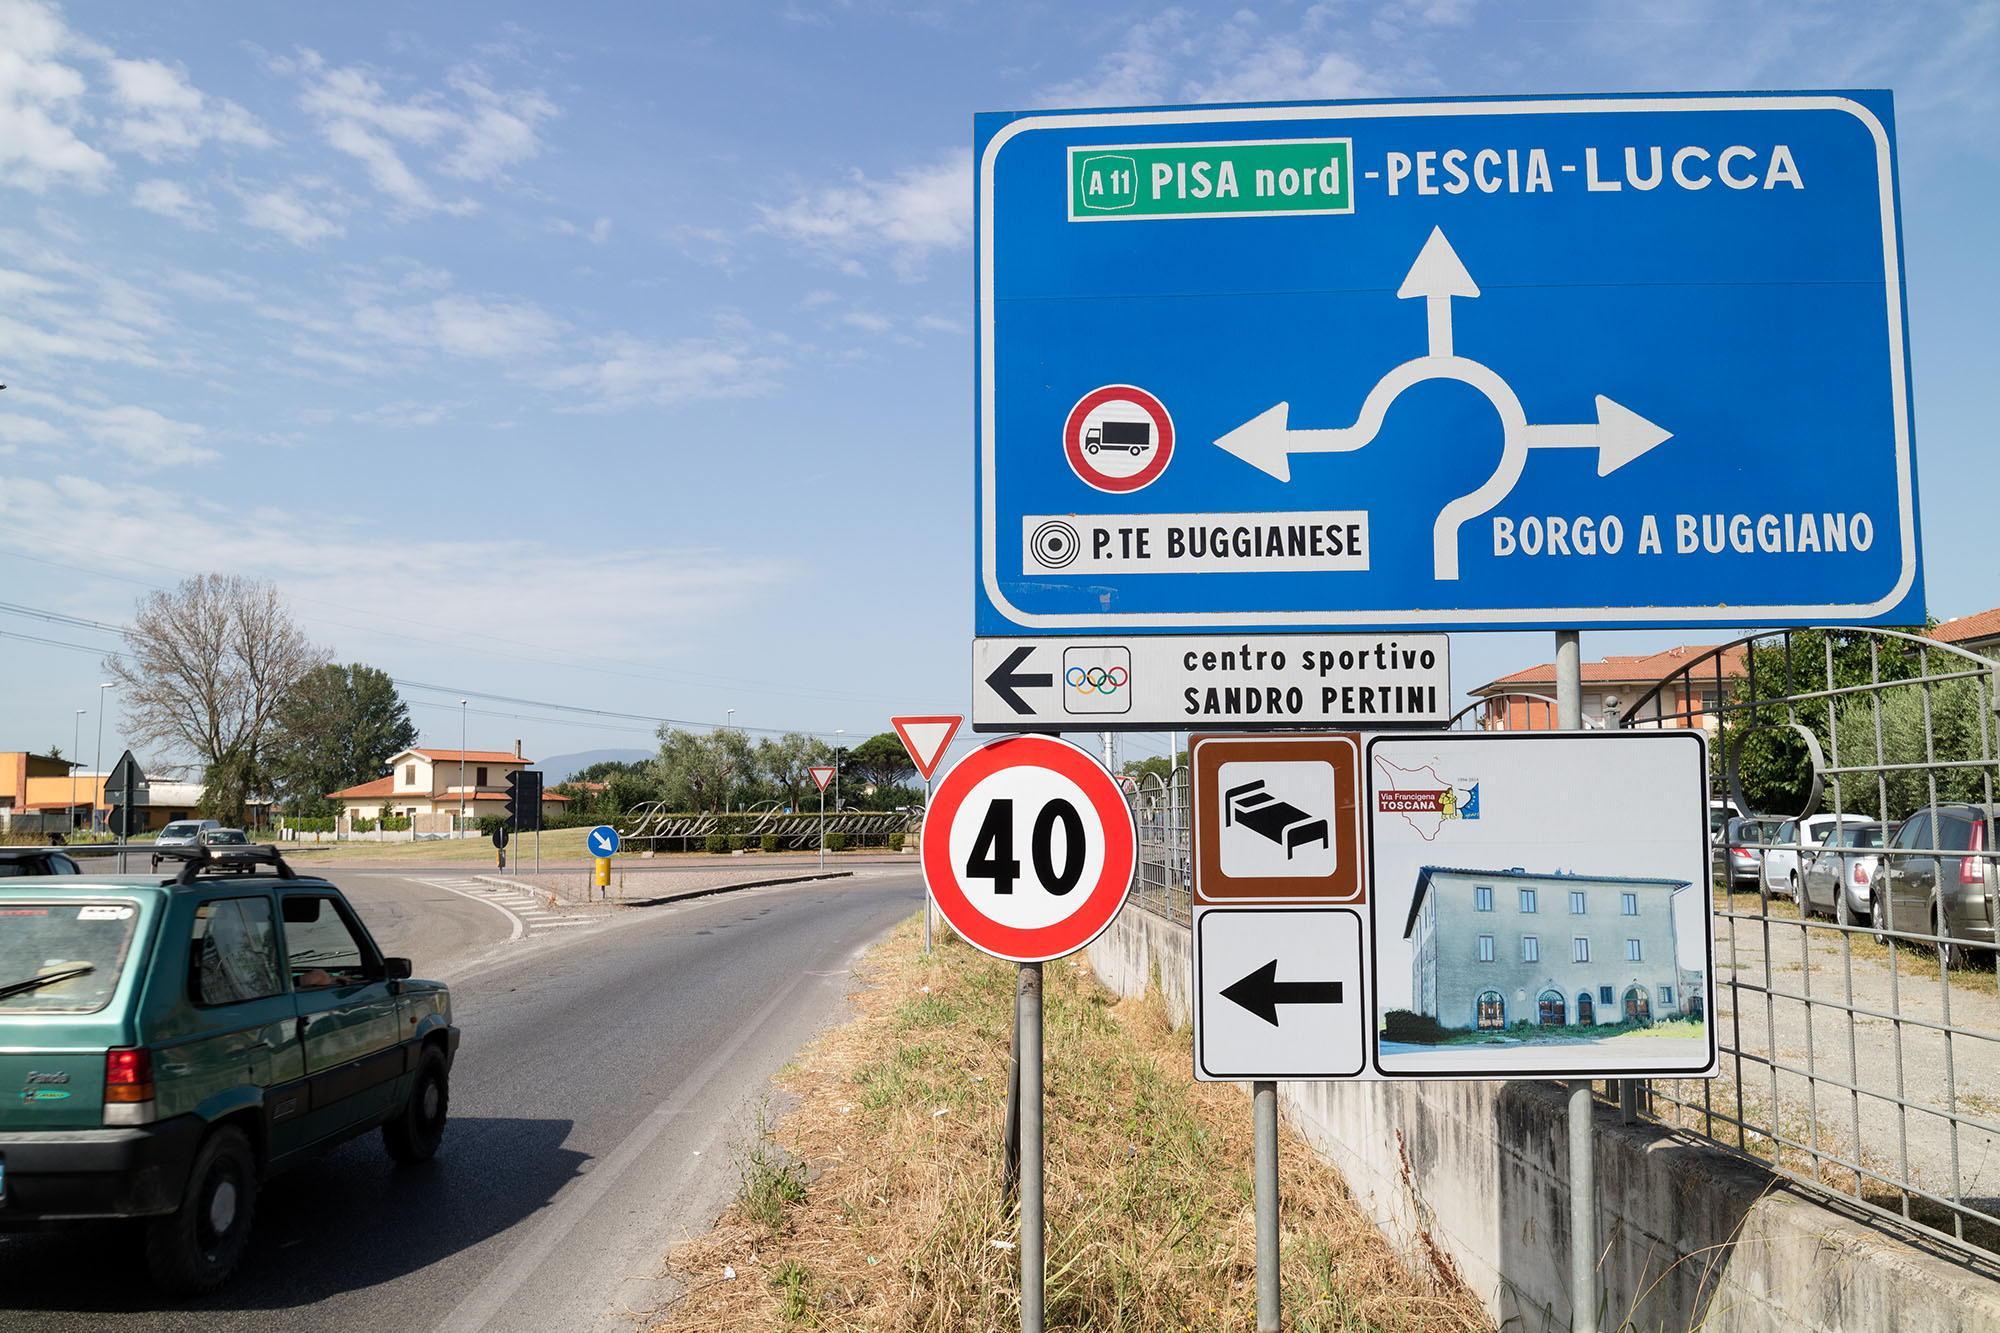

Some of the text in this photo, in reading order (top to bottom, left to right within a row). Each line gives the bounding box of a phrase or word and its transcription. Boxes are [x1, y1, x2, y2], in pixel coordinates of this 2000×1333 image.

[1152, 161, 1239, 199] PISA
[1256, 157, 1340, 197] nord
[1093, 524, 1361, 560] P.TE BUGGIANESE
[1493, 512, 1874, 556] BORGO A BUGGIANO
[1183, 642, 1435, 678] centro sportivo
[1184, 686, 1436, 715] SANDRO PERTINI
[1381, 801, 1436, 810] TOSCANA
[1394, 793, 1435, 801] Francigena
[966, 798, 1086, 896] 40
